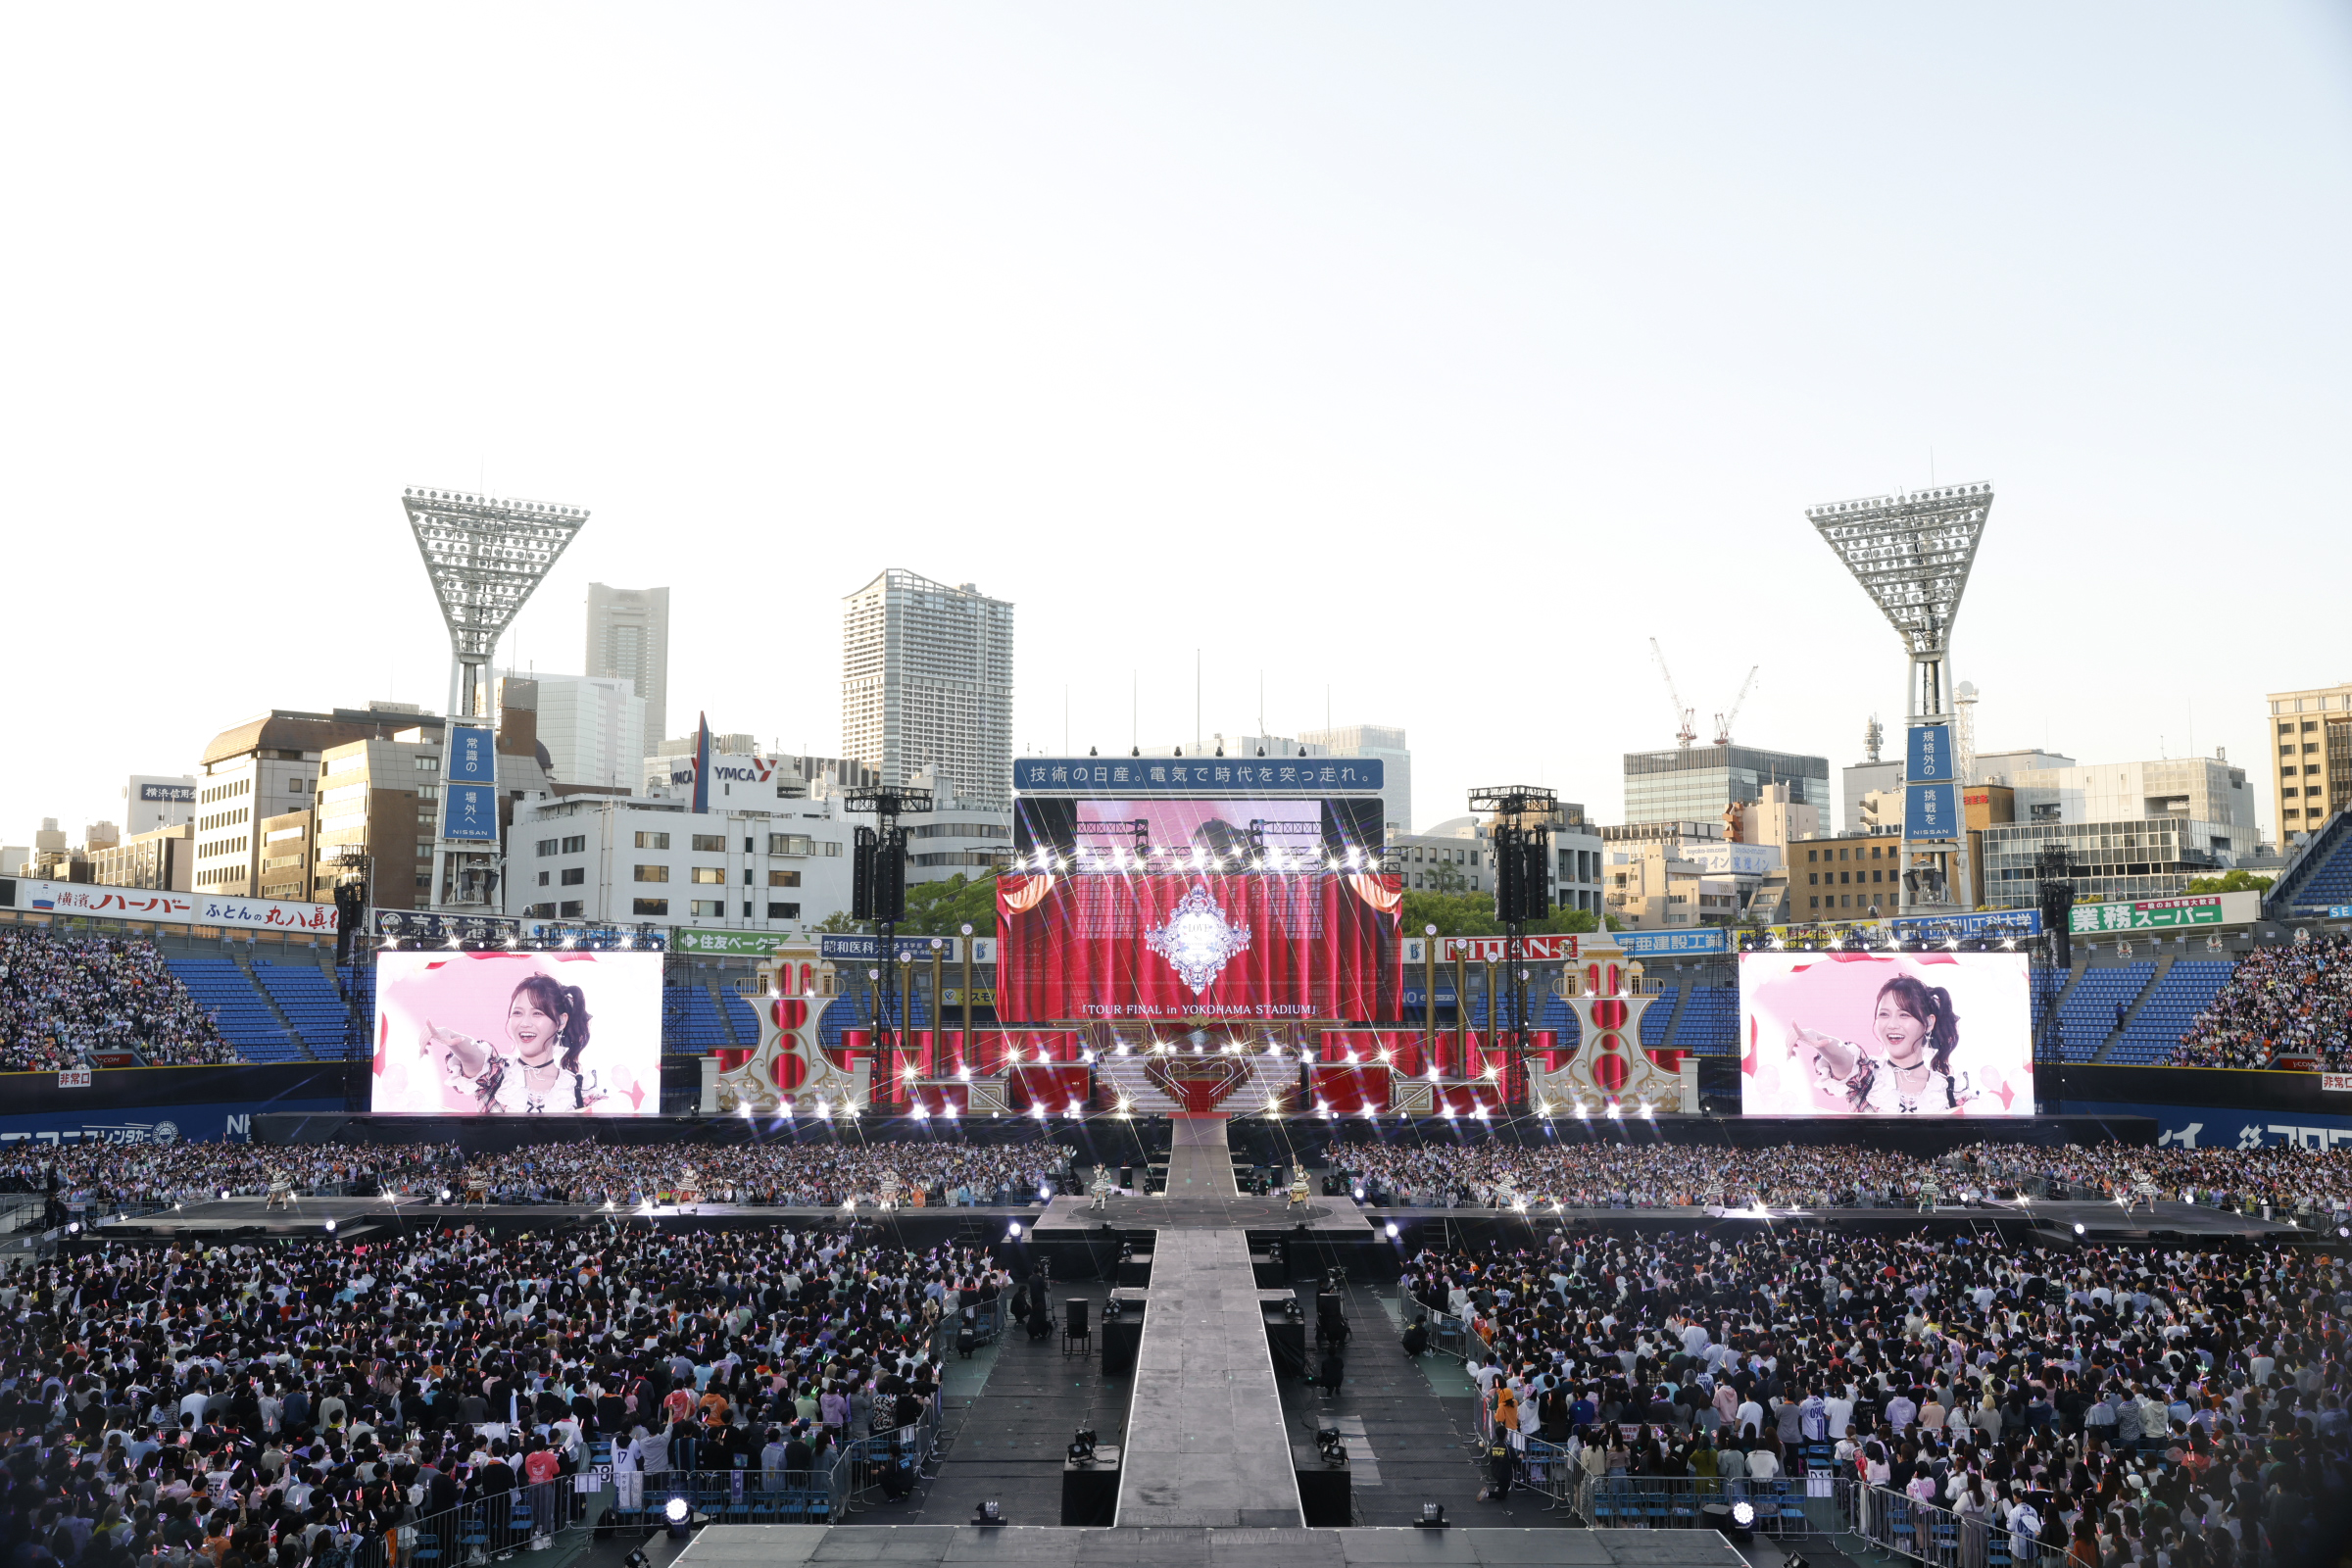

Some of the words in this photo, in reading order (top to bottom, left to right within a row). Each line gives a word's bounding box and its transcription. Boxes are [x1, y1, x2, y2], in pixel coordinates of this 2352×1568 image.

[466, 737, 478, 772] 常識の
[1923, 730, 1936, 775] 規格外の
[669, 770, 695, 785] YMCA
[714, 766, 757, 782] YMCA
[1030, 766, 1369, 782] 技術の日産。電気で時代を突っ走れ。
[465, 791, 477, 824] 場外へ
[1924, 789, 1936, 825] 挑戦を
[1735, 846, 1767, 856] toyoko-inn.com
[2138, 897, 2217, 910] 一般のお客様大歓迎
[2071, 905, 2214, 932] 業務スーパー
[1126, 1004, 1162, 1015] FINAL
[1166, 1005, 1177, 1014] in
[1182, 1004, 1251, 1015] YOKOHAMA
[59, 1072, 90, 1086] 非常口
[617, 1450, 627, 1464] 17
